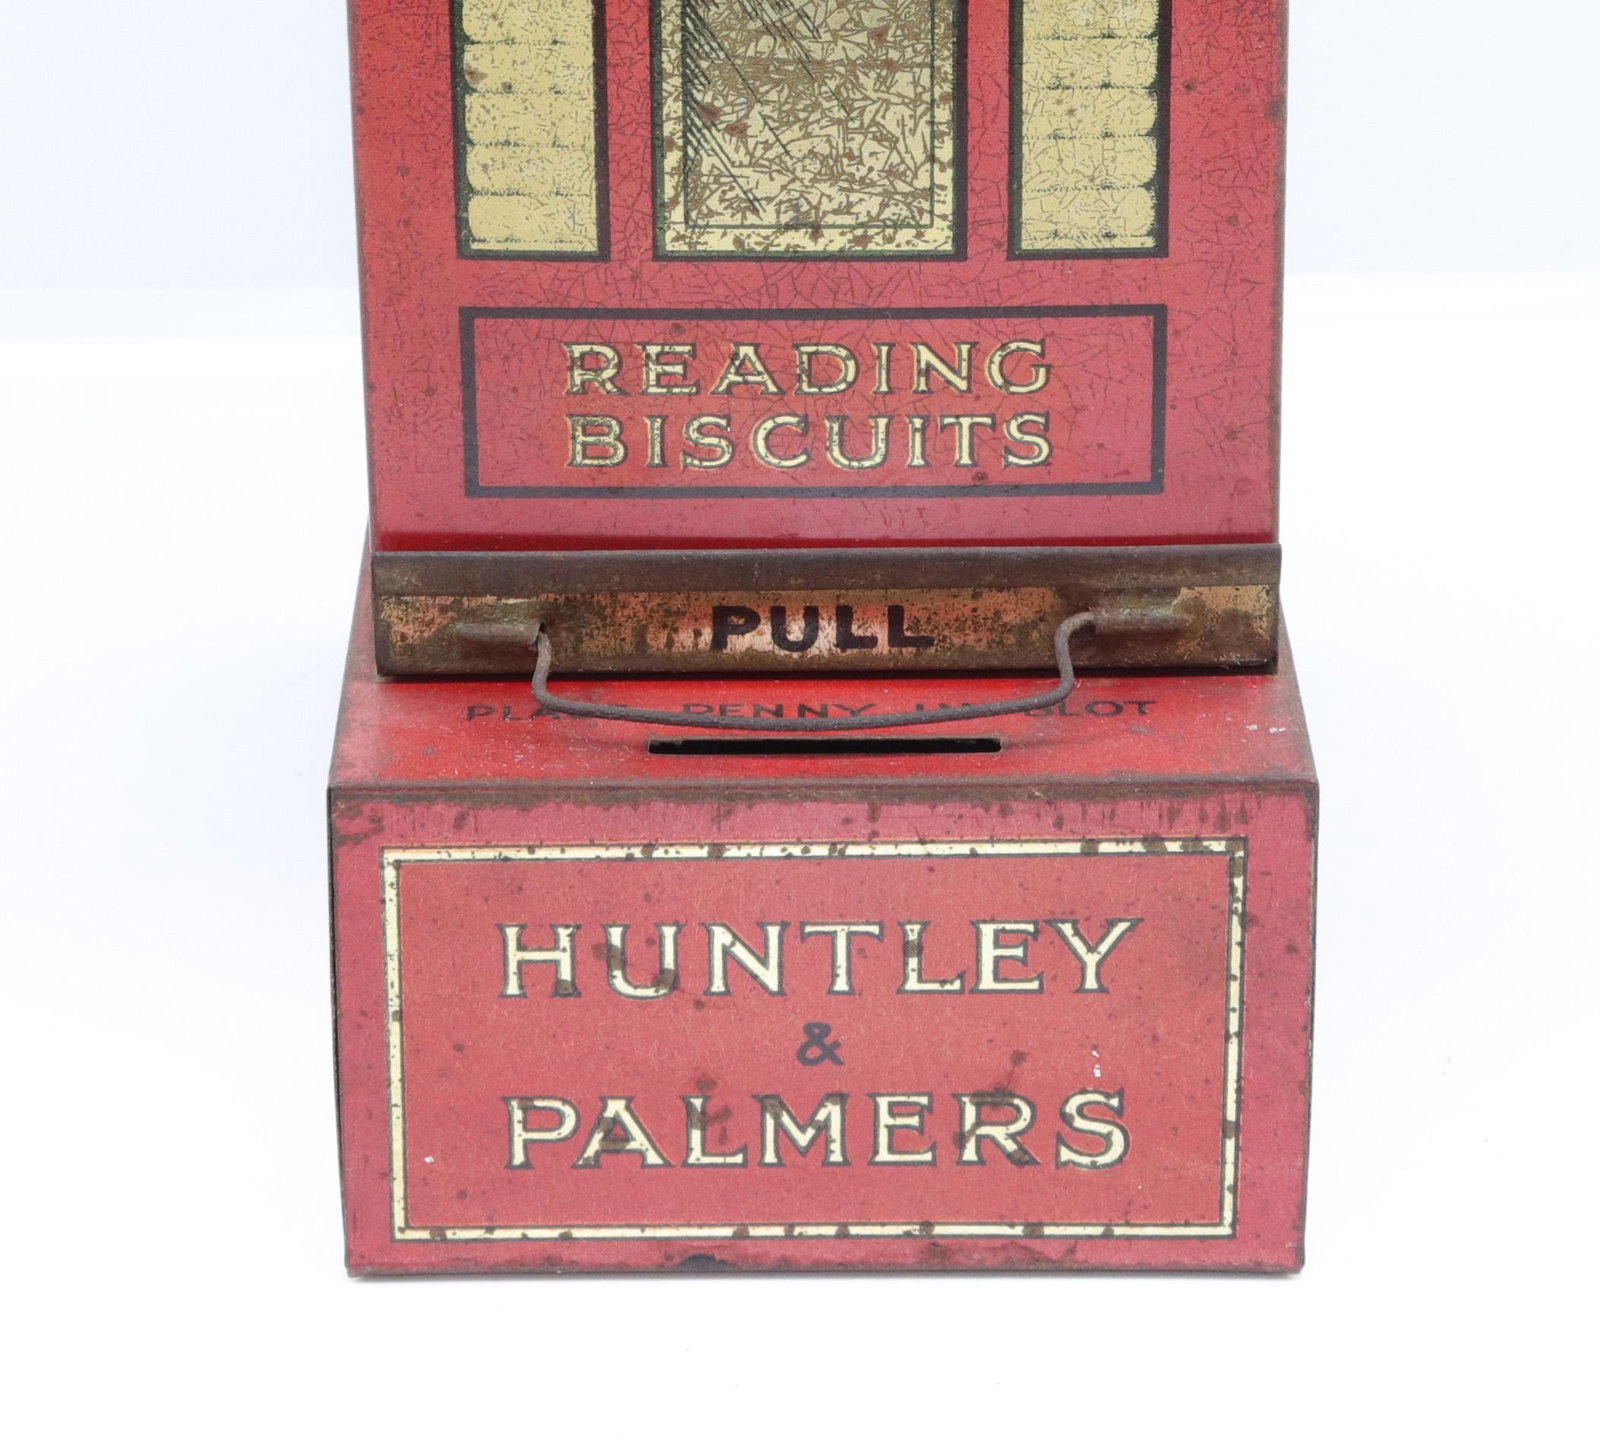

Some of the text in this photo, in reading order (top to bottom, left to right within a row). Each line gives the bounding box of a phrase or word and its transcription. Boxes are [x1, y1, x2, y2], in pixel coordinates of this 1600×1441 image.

[563, 340, 1052, 396] READING
[564, 411, 1053, 471] BISCUITS
[711, 604, 935, 653] PULL
[682, 702, 878, 719] PENNY
[497, 917, 1144, 1000] HUNTLEY
[796, 1022, 845, 1066] &
[501, 1088, 1131, 1170] PALMERS
